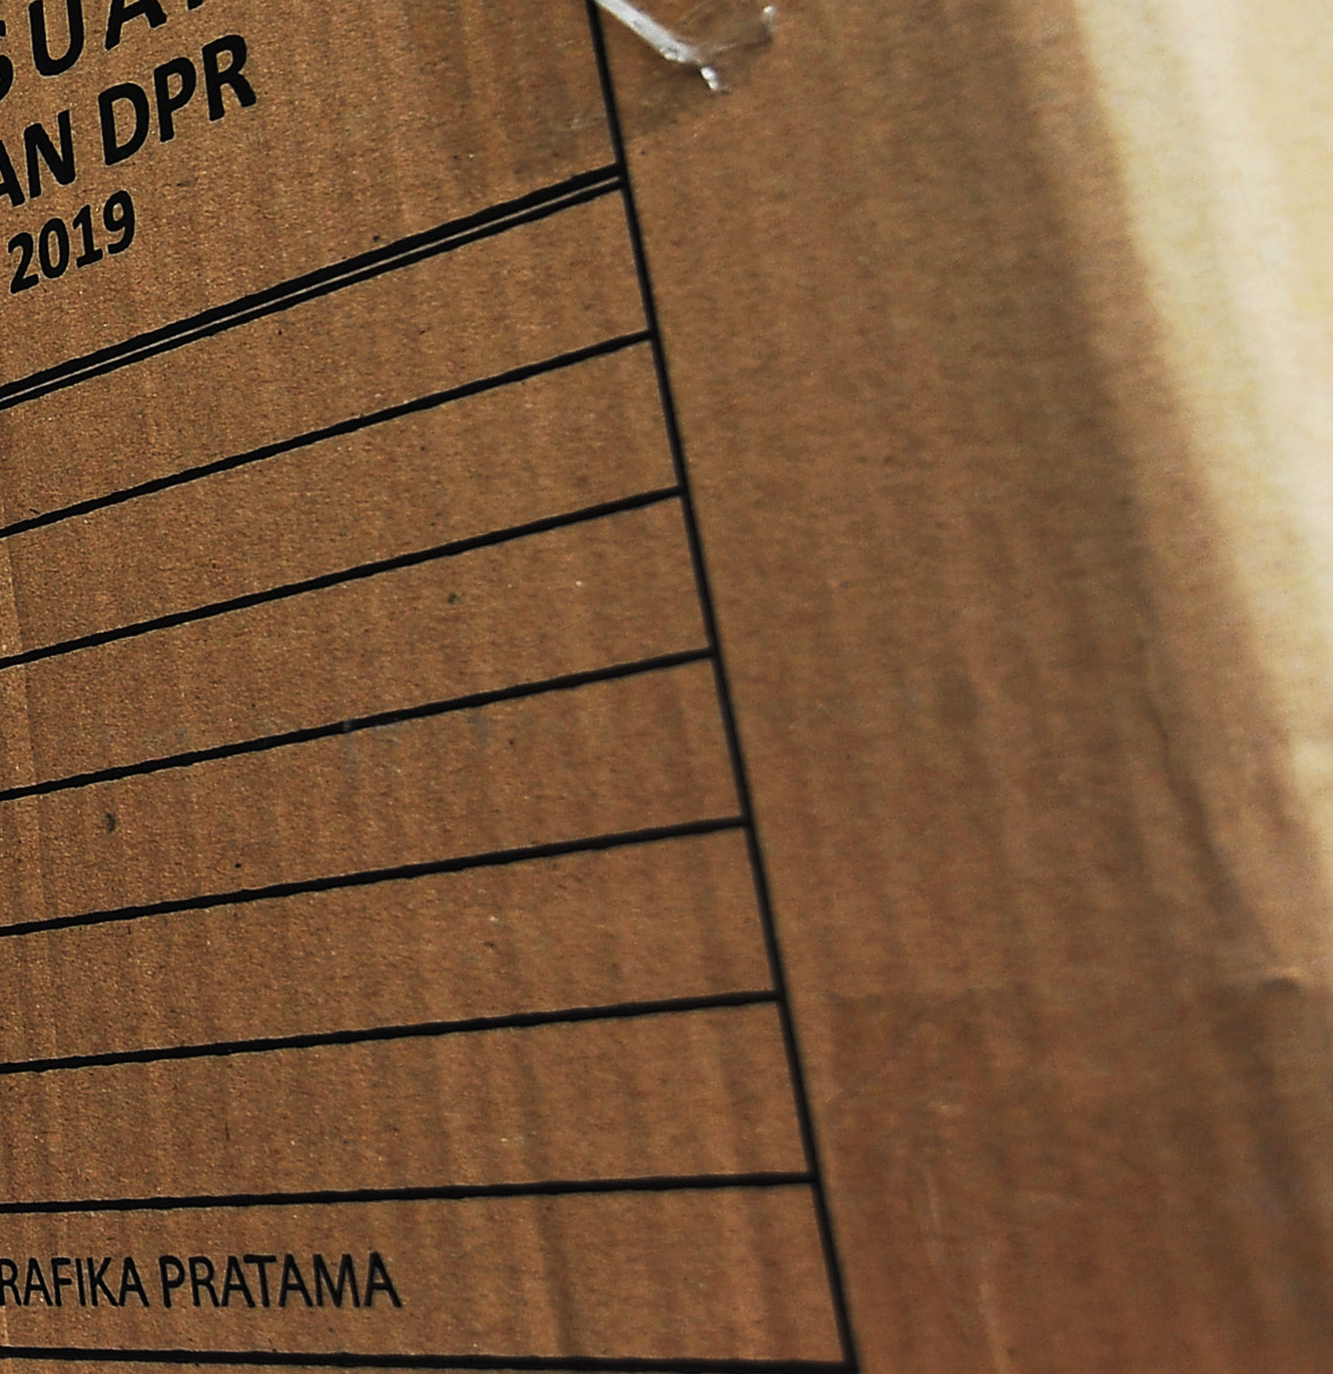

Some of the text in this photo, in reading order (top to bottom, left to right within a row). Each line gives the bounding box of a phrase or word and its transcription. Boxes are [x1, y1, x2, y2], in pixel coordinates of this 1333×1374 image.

[98, 34, 257, 167] DPR
[9, 191, 136, 295] 2019
[161, 1251, 403, 1309] PRATAMA
